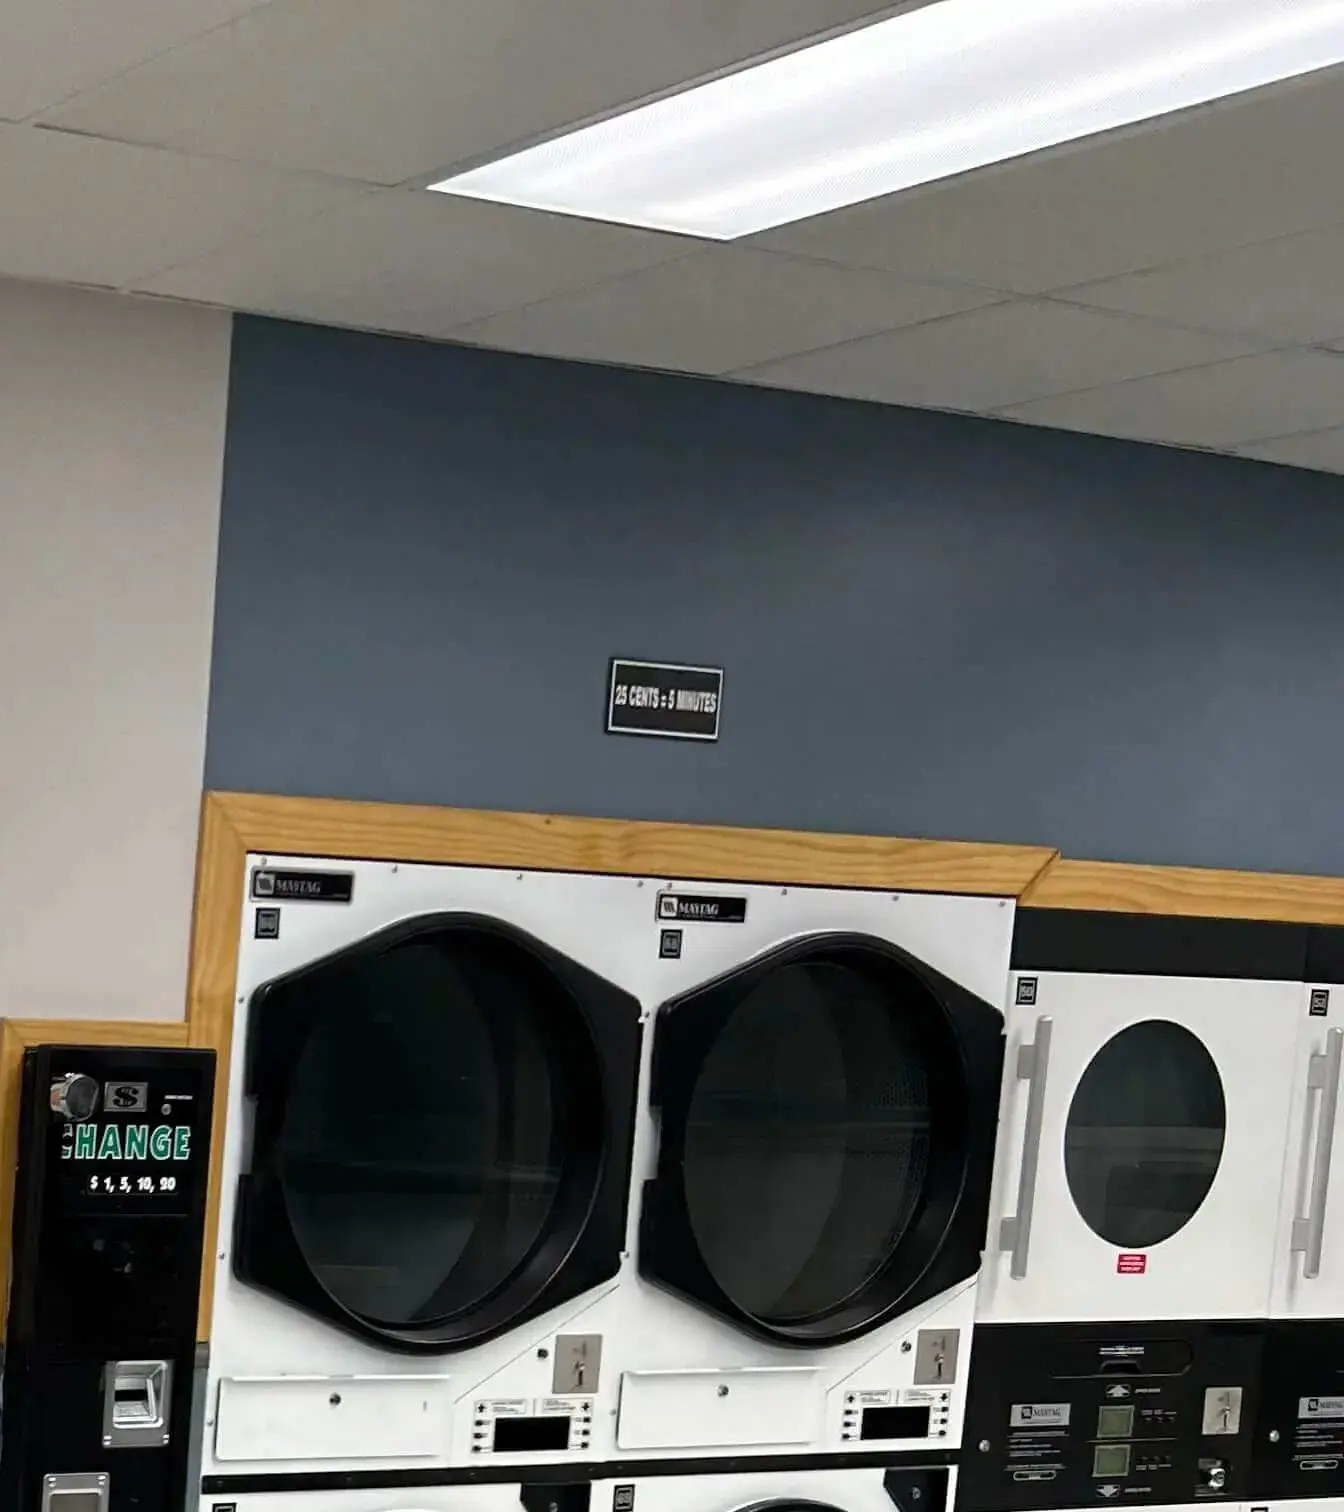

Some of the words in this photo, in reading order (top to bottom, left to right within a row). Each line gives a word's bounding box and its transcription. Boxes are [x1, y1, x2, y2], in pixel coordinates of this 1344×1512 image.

[615, 684, 628, 705] 25
[629, 685, 659, 709] CENTS
[668, 689, 675, 710] 5
[676, 689, 716, 713] MINUTES
[160, 1177, 176, 1191] 20
